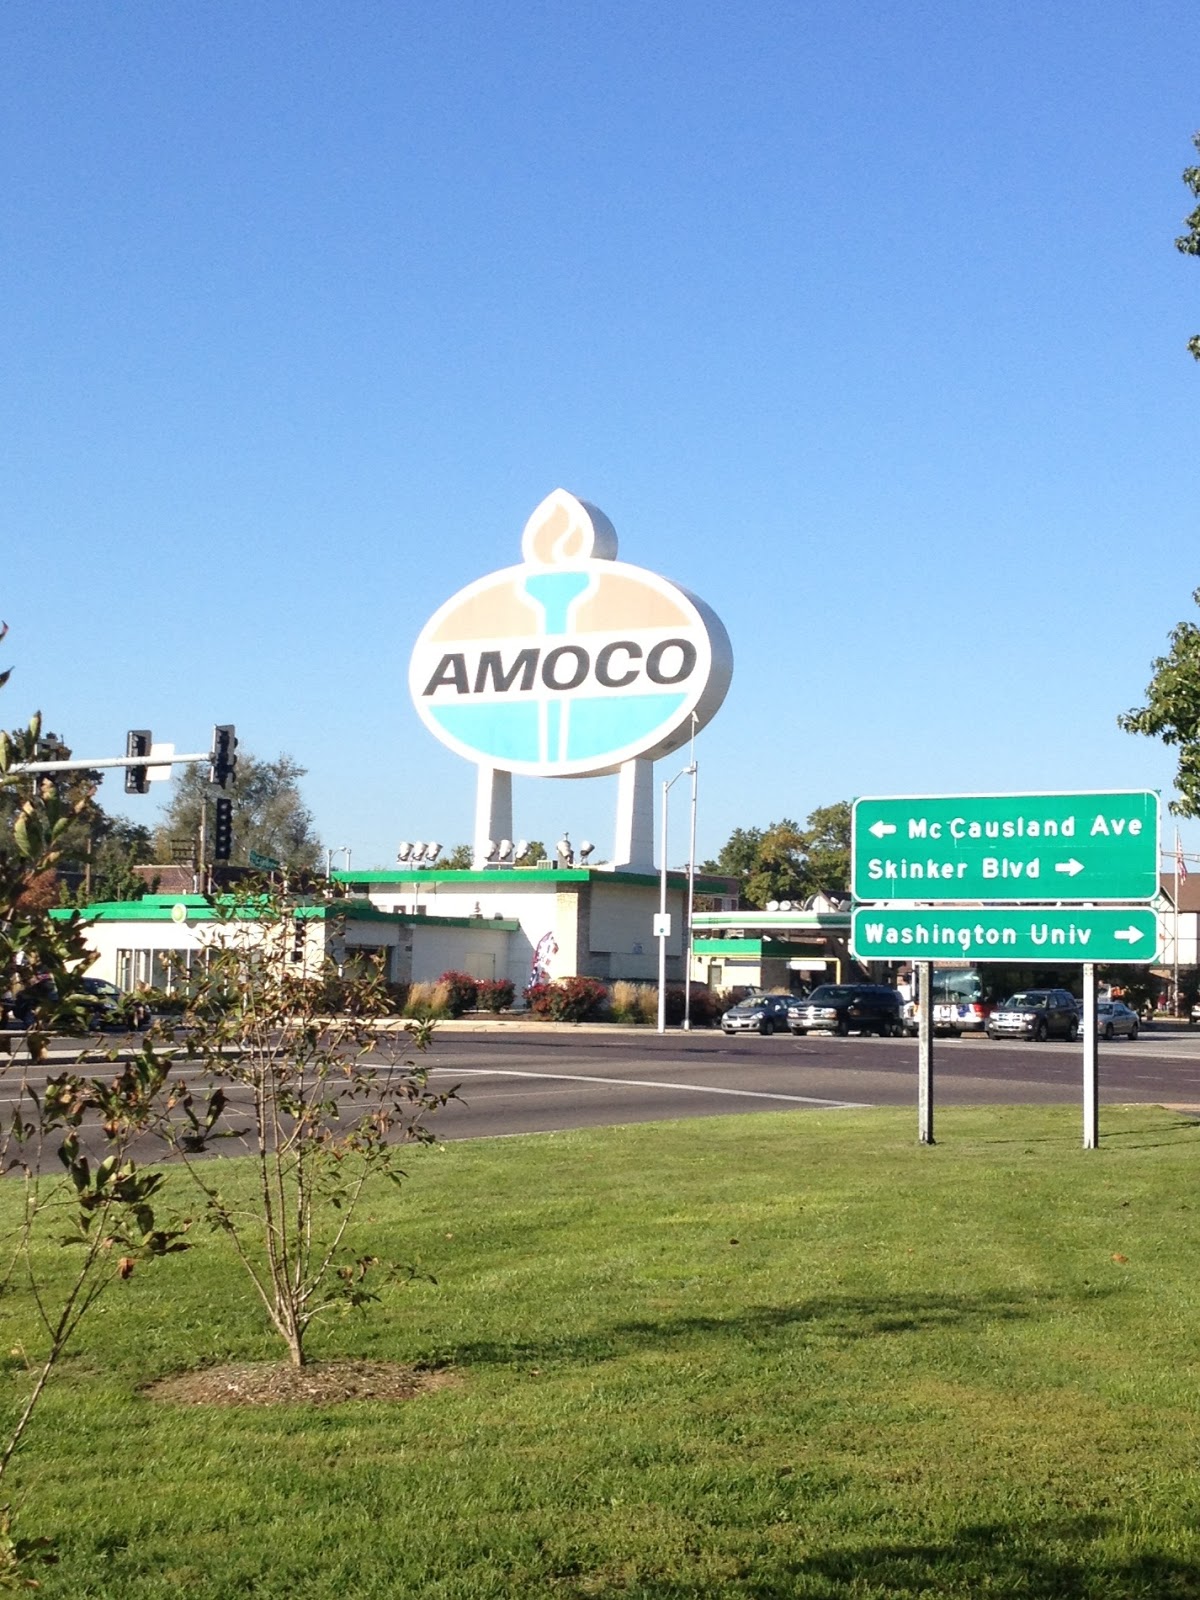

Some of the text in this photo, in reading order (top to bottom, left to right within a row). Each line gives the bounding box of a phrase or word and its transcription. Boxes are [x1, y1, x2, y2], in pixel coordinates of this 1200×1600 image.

[421, 638, 697, 697] AMOCO
[1091, 814, 1143, 836] Ave
[868, 857, 1040, 879] Skinker Blvd
[864, 922, 1092, 951] Washington Univ
